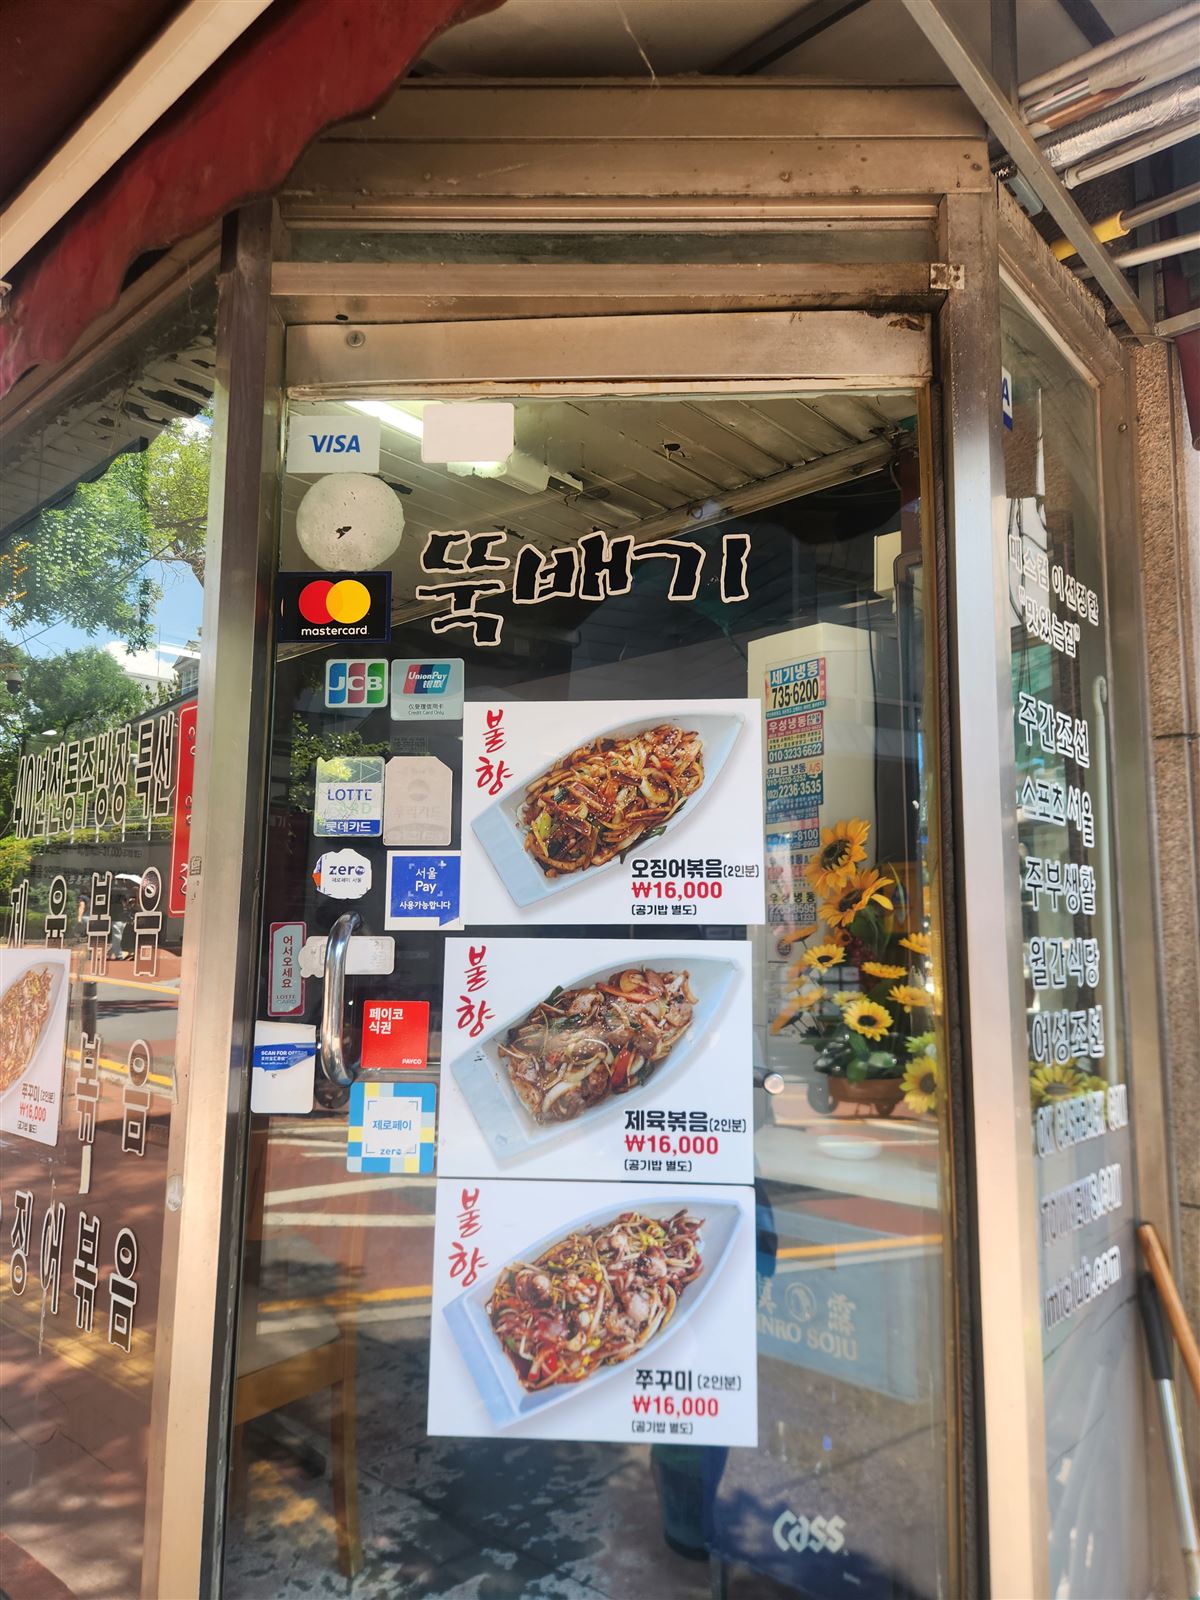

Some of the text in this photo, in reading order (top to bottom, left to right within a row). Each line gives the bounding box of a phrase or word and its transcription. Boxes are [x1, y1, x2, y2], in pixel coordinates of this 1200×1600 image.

[309, 434, 361, 453] VISA
[415, 530, 752, 647] 뚝배기
[301, 624, 369, 636] mastercard
[408, 671, 447, 681] UnionPay
[771, 659, 818, 686] 세기냉동
[329, 675, 382, 692] JCB
[771, 677, 819, 709] 735-6200
[1019, 692, 1090, 769] 주간조선
[475, 708, 515, 796] 불향
[327, 789, 372, 801] LOTTE
[324, 820, 372, 834] 롯데카드
[329, 865, 366, 876] zero
[415, 866, 438, 880] 서울
[415, 881, 437, 894] Pay
[631, 881, 723, 901] ₩16,000
[1025, 856, 1096, 915] 주부생활
[399, 900, 452, 911] 사용가능합니다
[631, 904, 697, 916] (공기밥 별도)
[281, 935, 293, 989] 어서오세요
[1030, 936, 1101, 990] 월간식당
[456, 945, 496, 1038] 불향
[369, 1008, 404, 1021] 페이코
[368, 1021, 392, 1035] 식권
[1032, 1005, 1105, 1067] 여성조선
[372, 1119, 413, 1131] 제로페이
[380, 1147, 402, 1155] zero
[624, 1134, 719, 1156] ₩16,000
[624, 1159, 693, 1173] (공기밥 별도)
[448, 1187, 489, 1288] 불향
[0, 1189, 137, 1353] 징어볶음
[806, 1326, 857, 1362] SOJU
[635, 1369, 693, 1392] 쭈꾸미
[632, 1395, 719, 1418] ₩16,000
[631, 1420, 694, 1435] (공기밥 별도)
[772, 1509, 847, 1553] Cass
